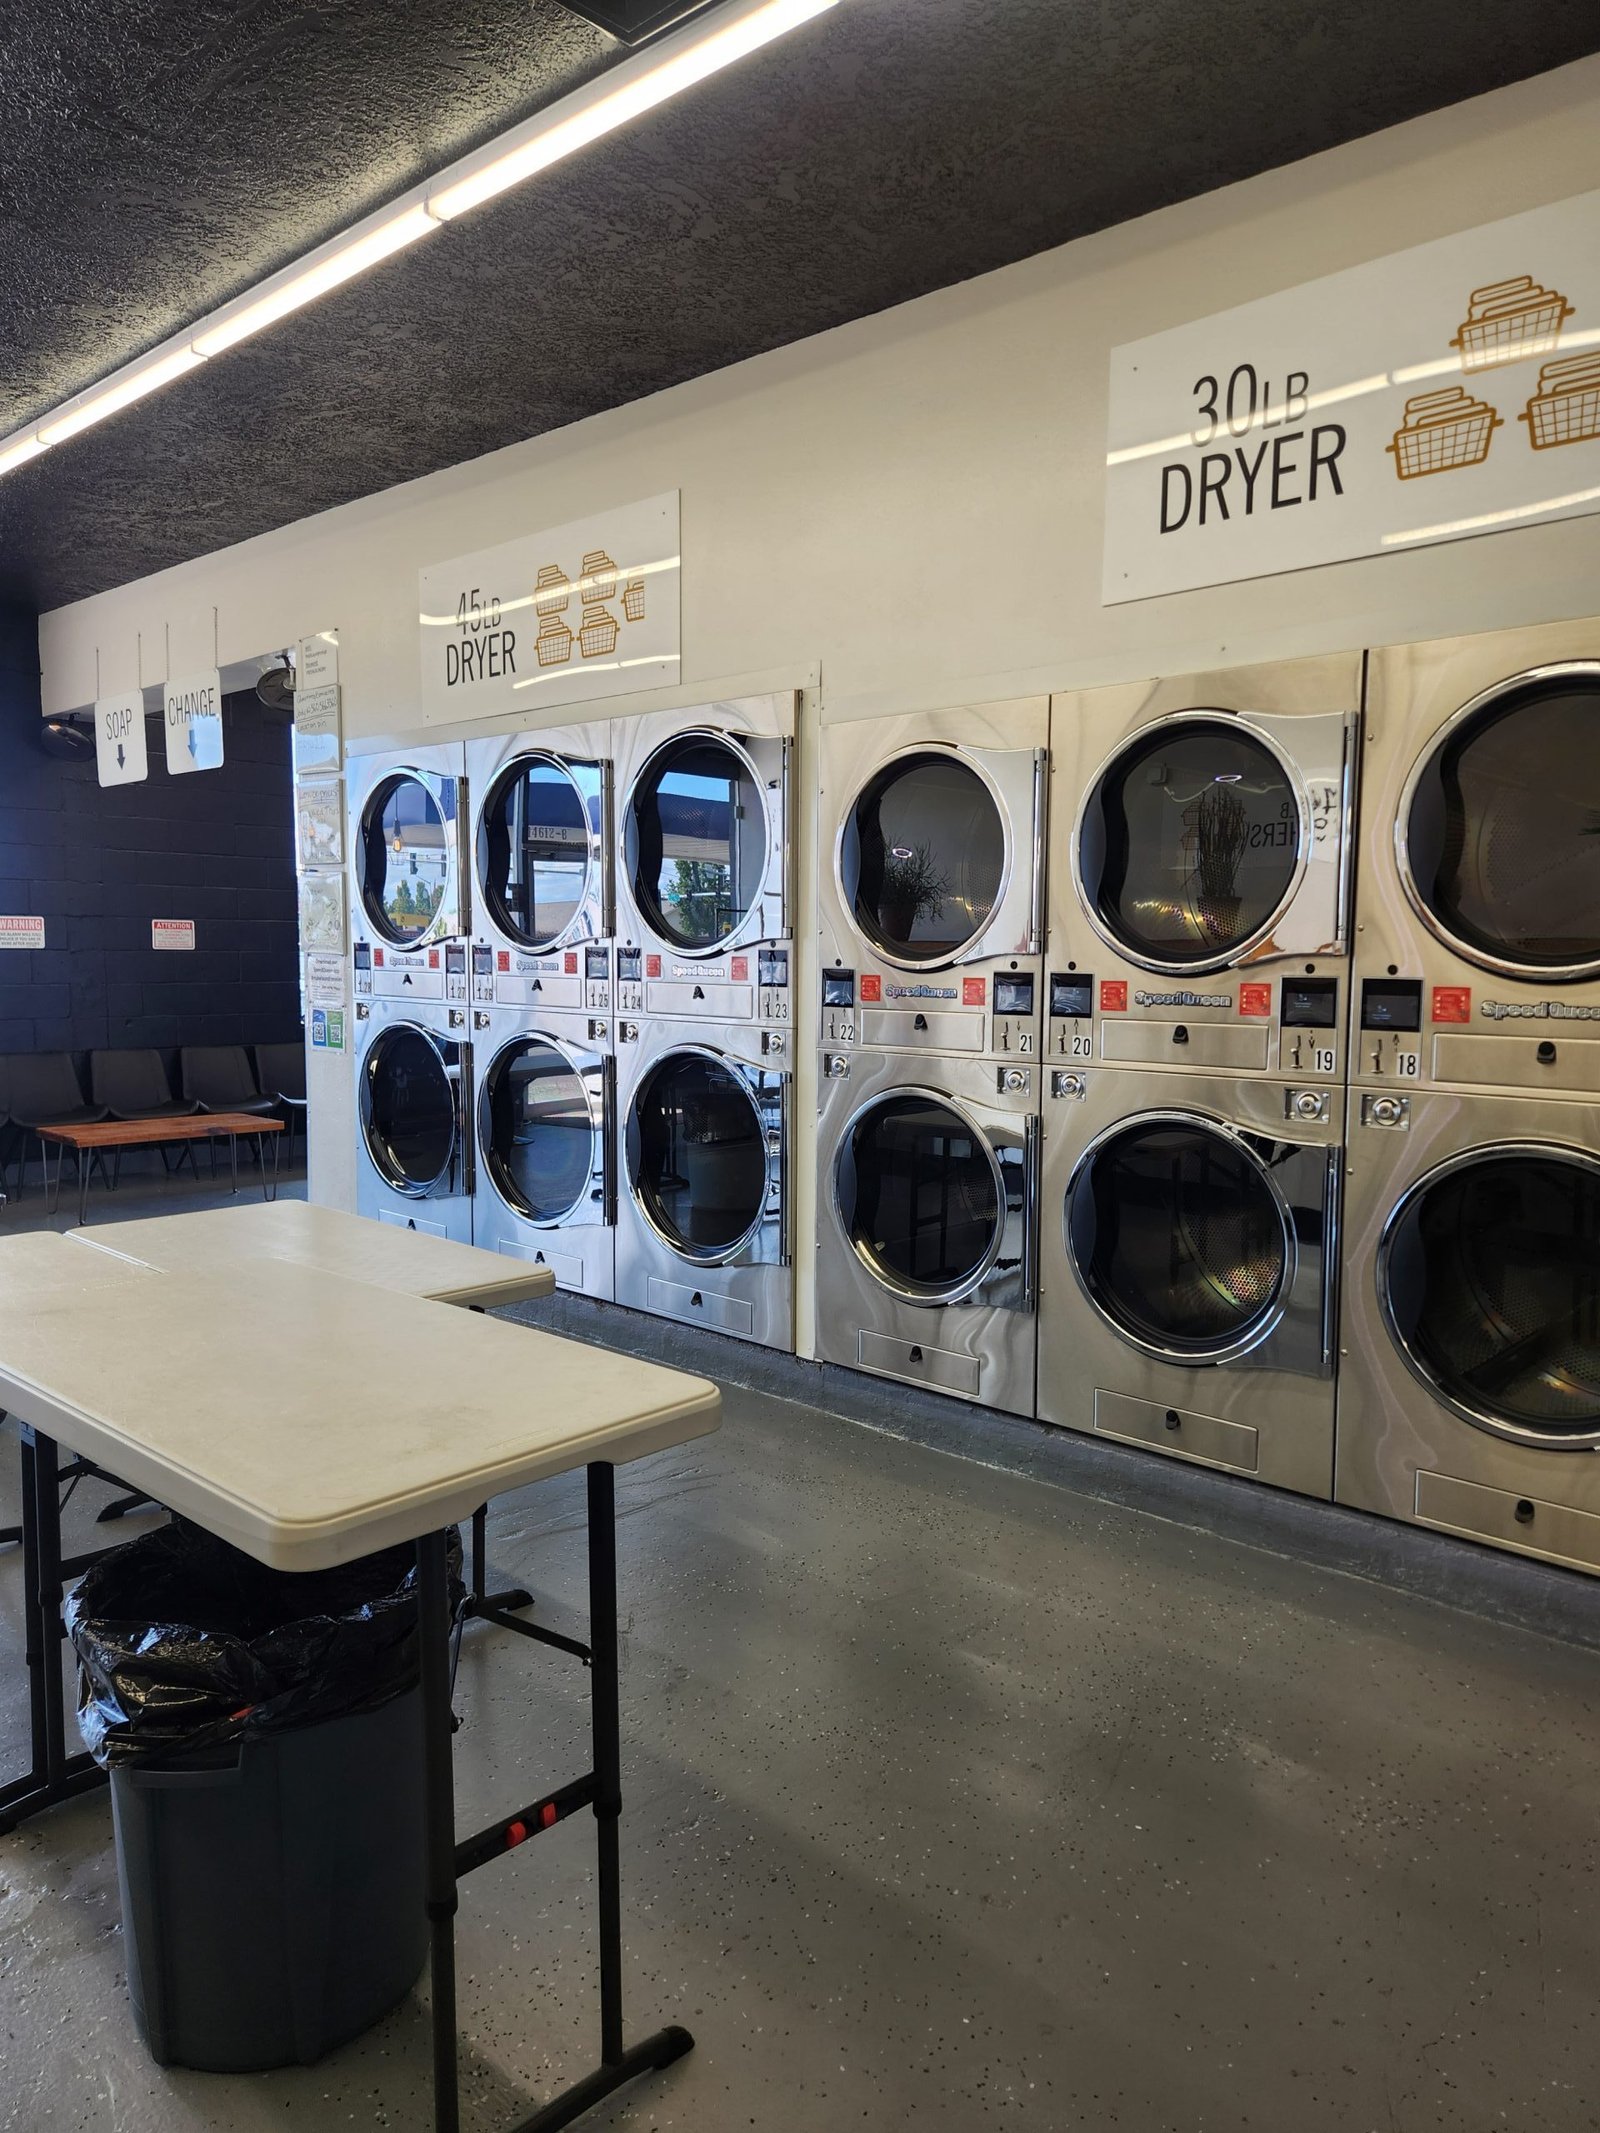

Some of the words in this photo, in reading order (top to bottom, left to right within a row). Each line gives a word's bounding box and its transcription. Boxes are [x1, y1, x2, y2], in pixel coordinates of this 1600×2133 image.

[1190, 363, 1309, 448] 30LB
[1160, 424, 1346, 534] DRYER
[447, 631, 516, 687] DRYER
[168, 688, 216, 726] CHANGE
[106, 709, 132, 740] SOAP
[0, 919, 41, 929] WARNING
[599, 993, 608, 1008] 25
[631, 995, 641, 1010] 24
[775, 1003, 787, 1018] 23
[840, 1024, 853, 1040] 22
[1020, 1035, 1033, 1052] 21
[1073, 1037, 1091, 1056] 20
[1316, 1050, 1333, 1070] 19
[1398, 1054, 1416, 1075] 18
